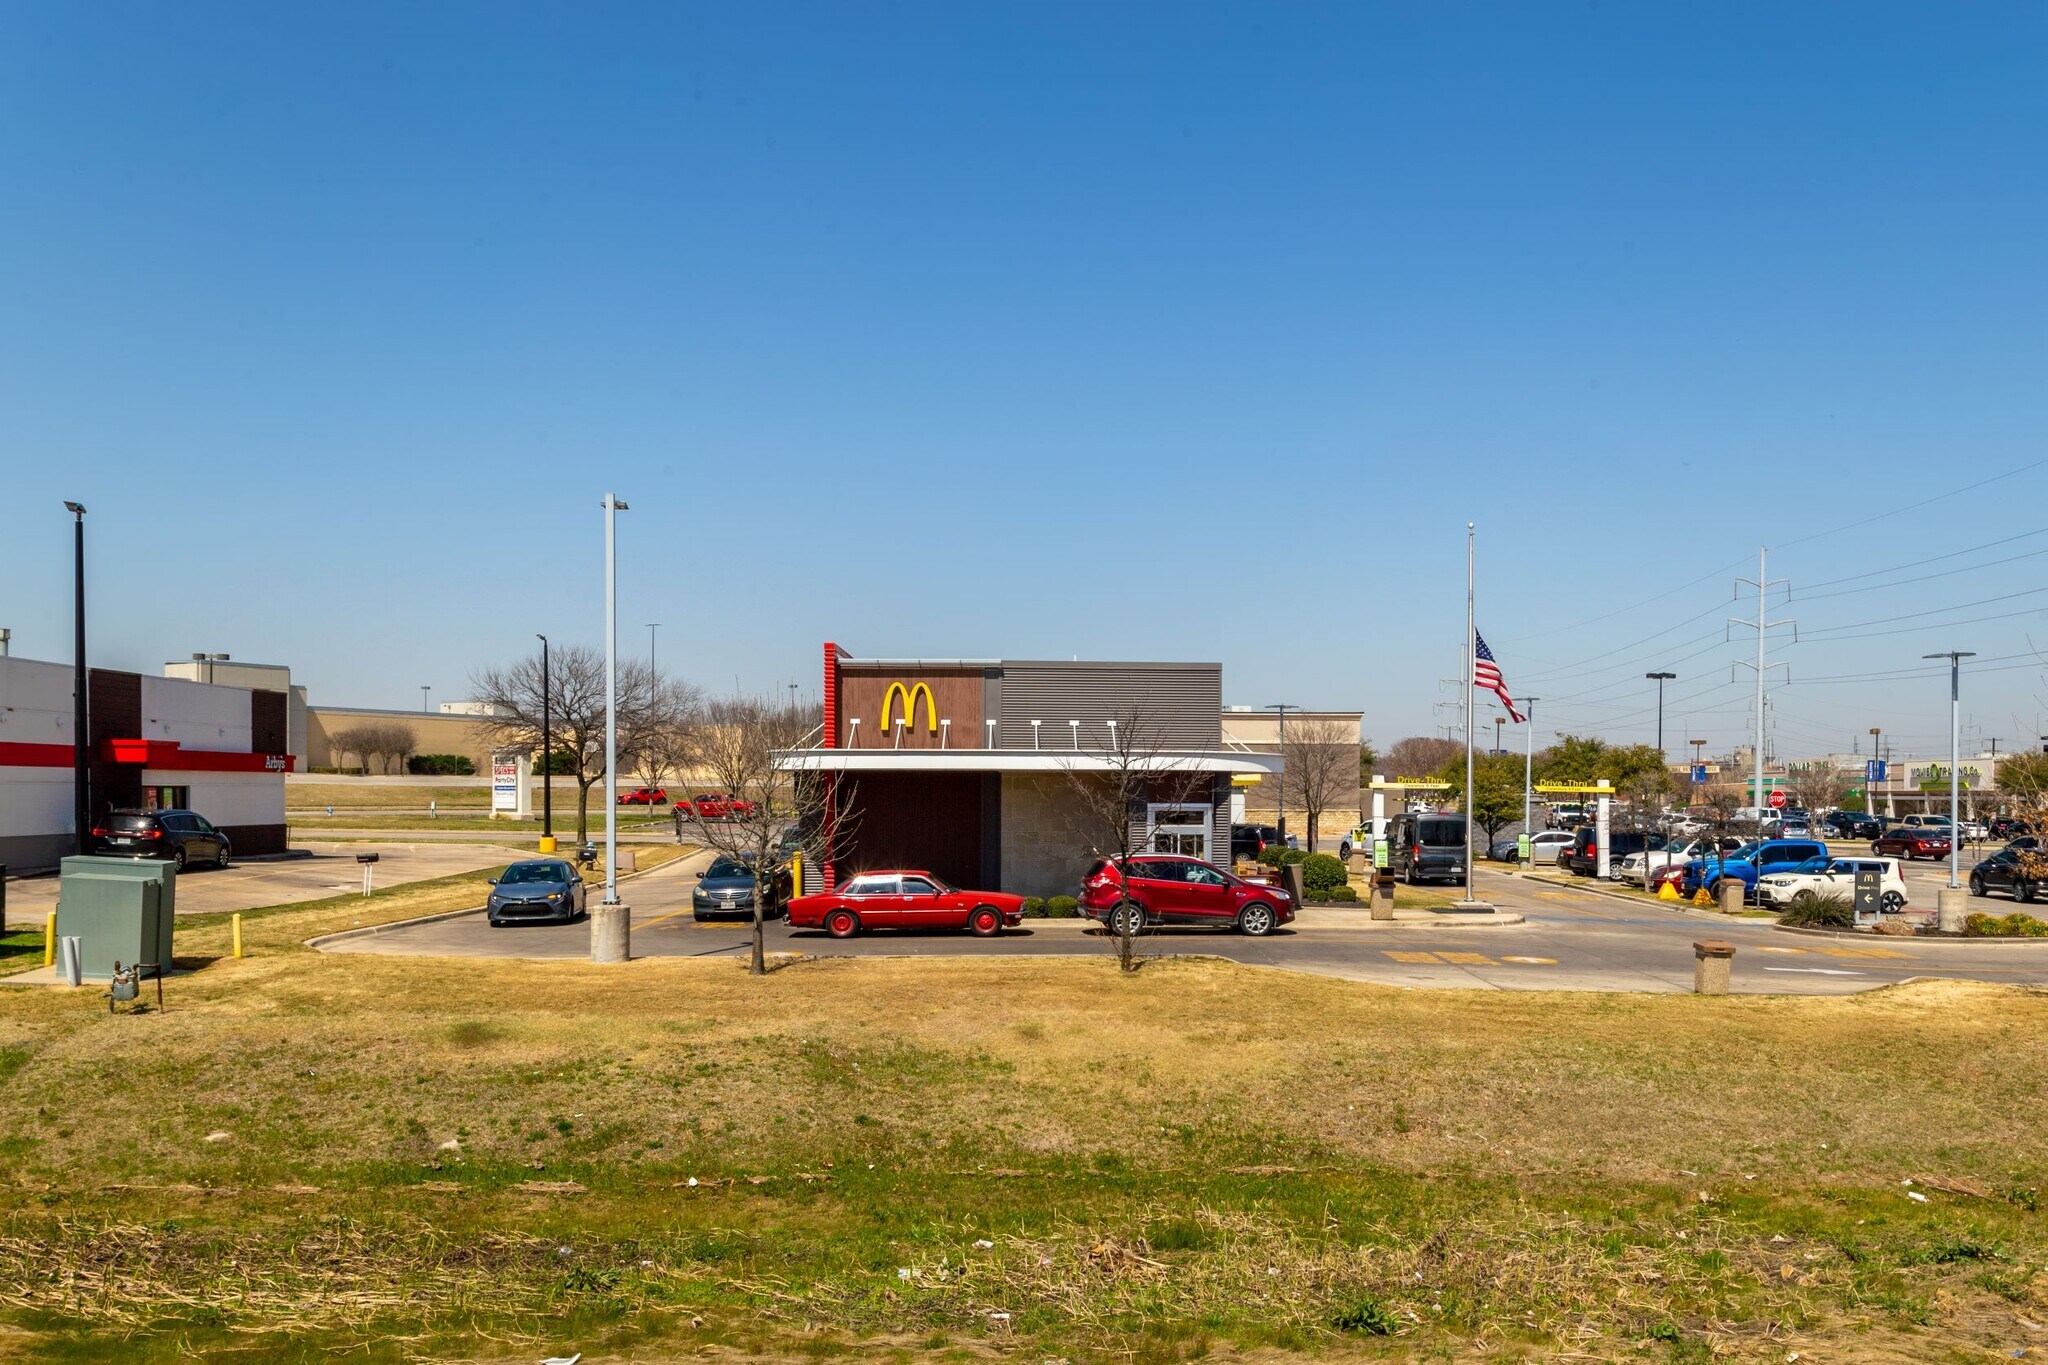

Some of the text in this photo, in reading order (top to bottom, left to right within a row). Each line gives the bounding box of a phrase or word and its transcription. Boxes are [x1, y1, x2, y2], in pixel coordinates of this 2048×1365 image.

[265, 755, 286, 772] Arby's
[1789, 762, 1811, 771] DOLLAR
[1911, 768, 1931, 777] MOVIE
[1939, 767, 1968, 776] TRANG
[1770, 795, 1785, 803] STOP
